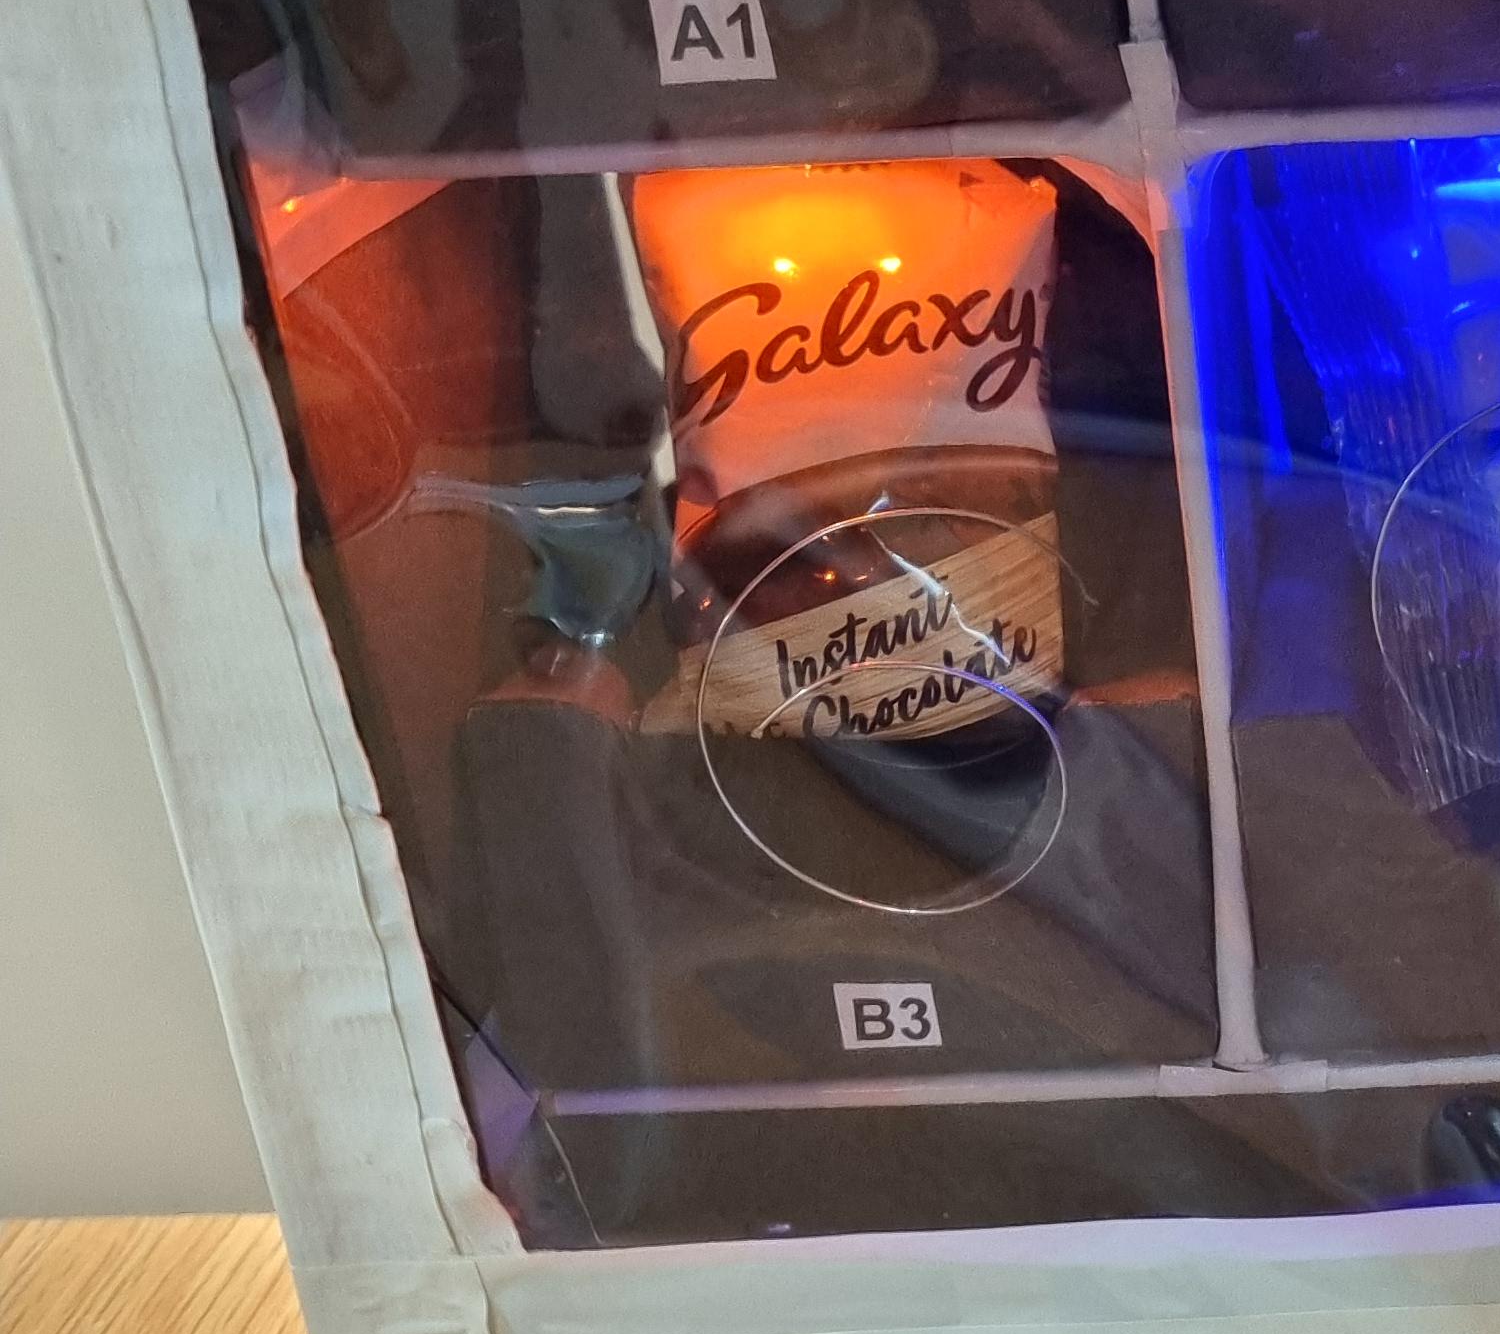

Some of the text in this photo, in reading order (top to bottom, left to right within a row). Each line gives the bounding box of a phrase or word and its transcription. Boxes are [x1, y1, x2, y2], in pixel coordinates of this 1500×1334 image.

[671, 2, 756, 62] A1
[673, 269, 1043, 430] Galaxy
[775, 570, 954, 703] Instant
[802, 617, 1038, 741] Chocolate
[852, 996, 931, 1041] B3
